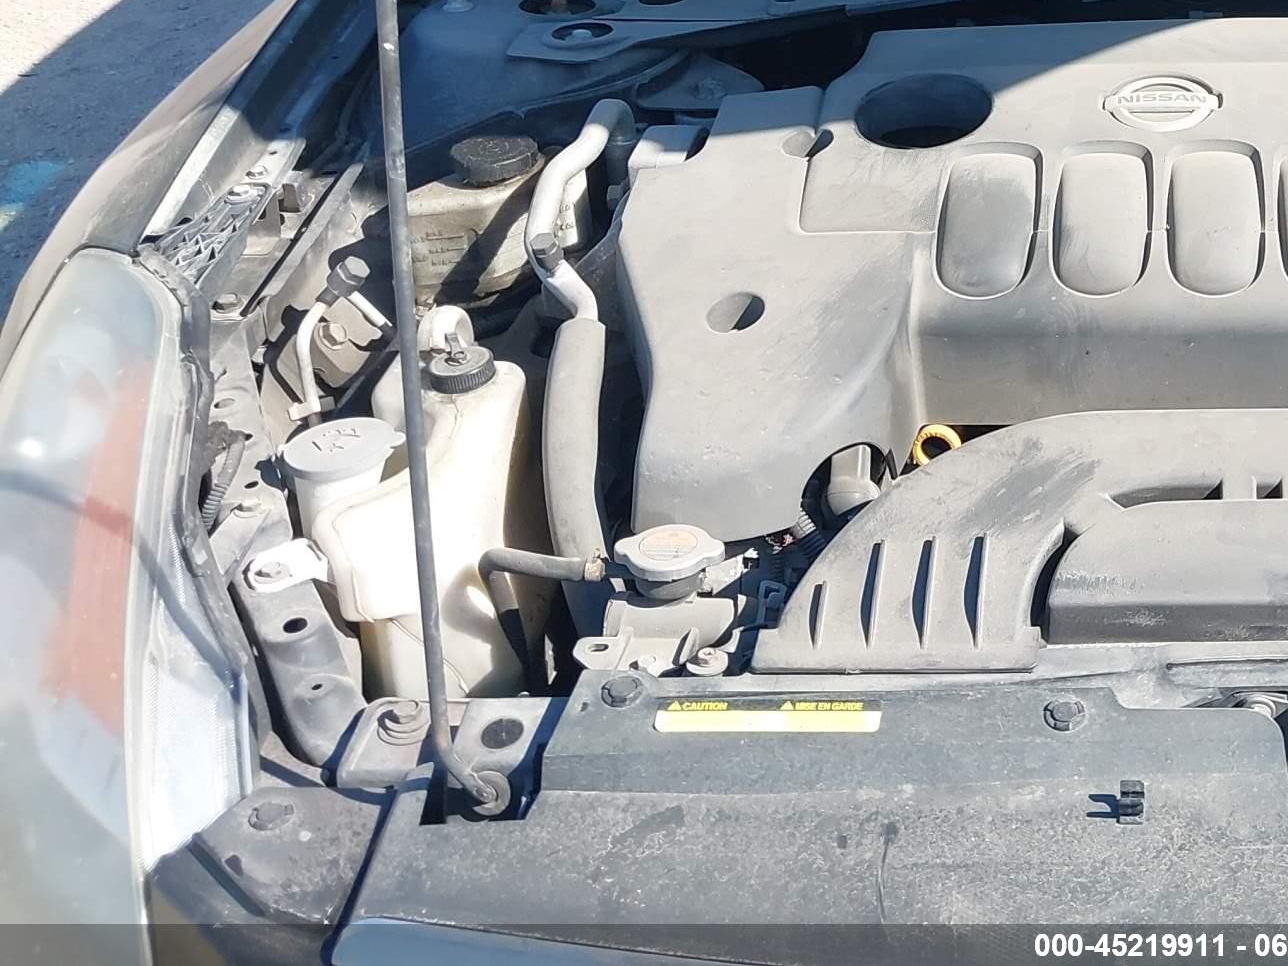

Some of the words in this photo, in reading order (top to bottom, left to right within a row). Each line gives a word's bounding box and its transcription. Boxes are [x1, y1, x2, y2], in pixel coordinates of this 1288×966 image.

[1118, 94, 1206, 104] NISSAN
[682, 702, 728, 711] CAUTION
[795, 702, 817, 711] MISE
[818, 702, 831, 711] EN
[831, 702, 864, 711] GARDE
